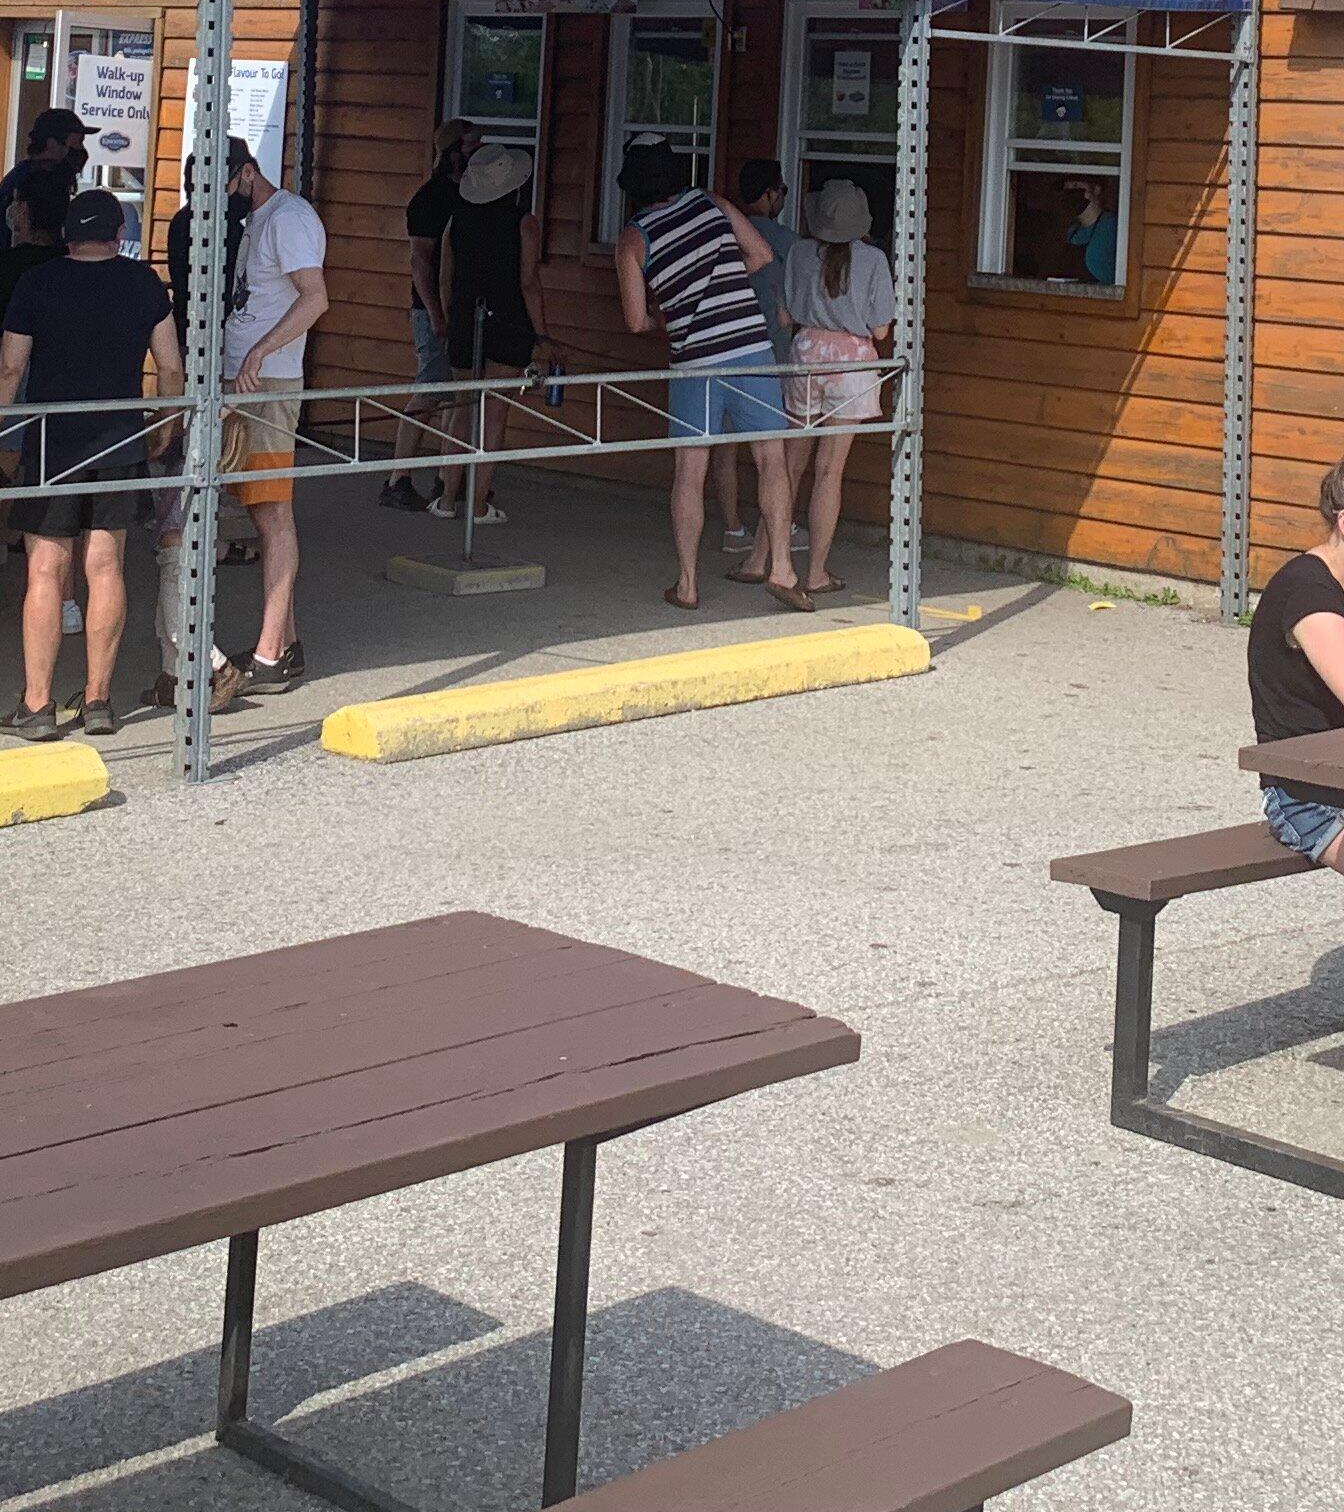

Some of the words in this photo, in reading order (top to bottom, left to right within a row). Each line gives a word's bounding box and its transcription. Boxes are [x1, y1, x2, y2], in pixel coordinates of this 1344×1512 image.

[96, 66, 145, 86] Walk-up
[232, 68, 258, 78] lavour
[261, 68, 270, 79] To
[96, 84, 143, 100] Window
[81, 103, 124, 118] Service
